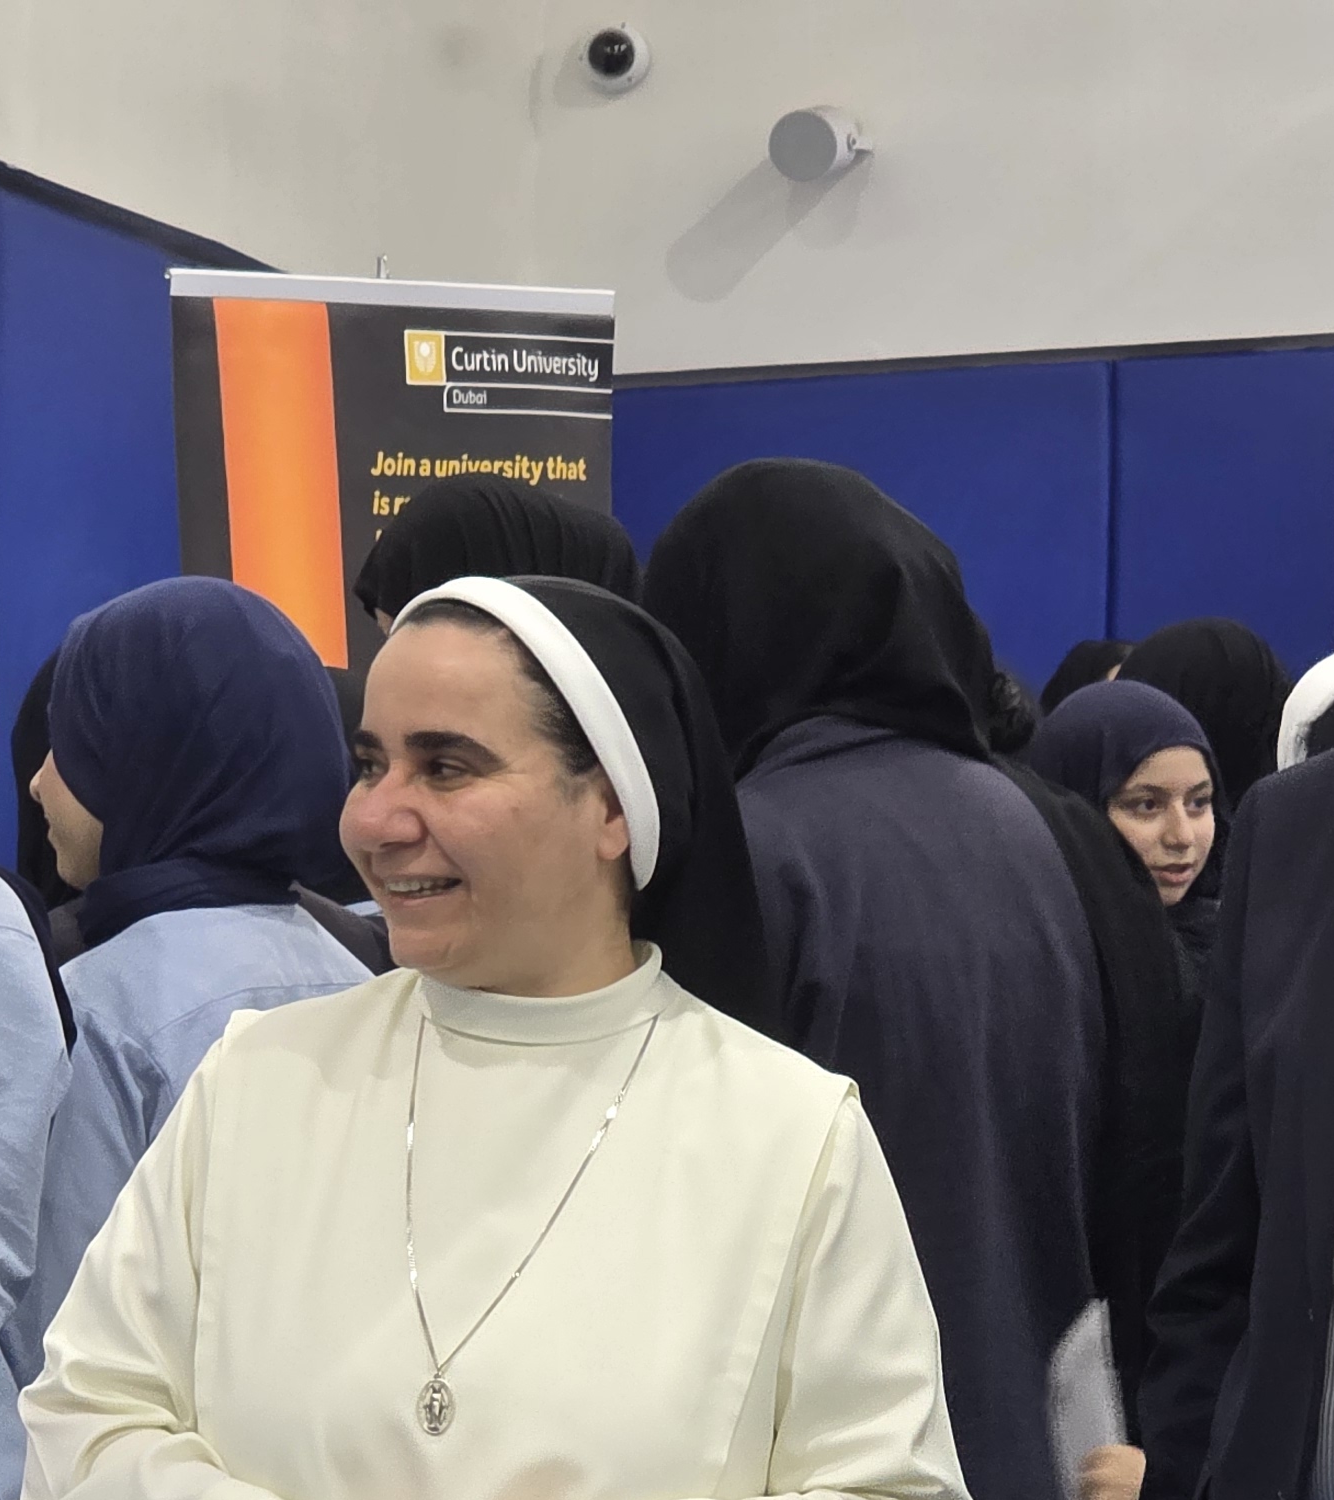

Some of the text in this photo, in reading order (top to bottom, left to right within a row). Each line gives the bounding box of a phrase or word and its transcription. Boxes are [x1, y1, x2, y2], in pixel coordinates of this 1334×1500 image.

[451, 346, 599, 382] Curtin University
[452, 389, 488, 405] Dubai
[370, 451, 587, 486] Join a university that
[372, 489, 390, 515] is
